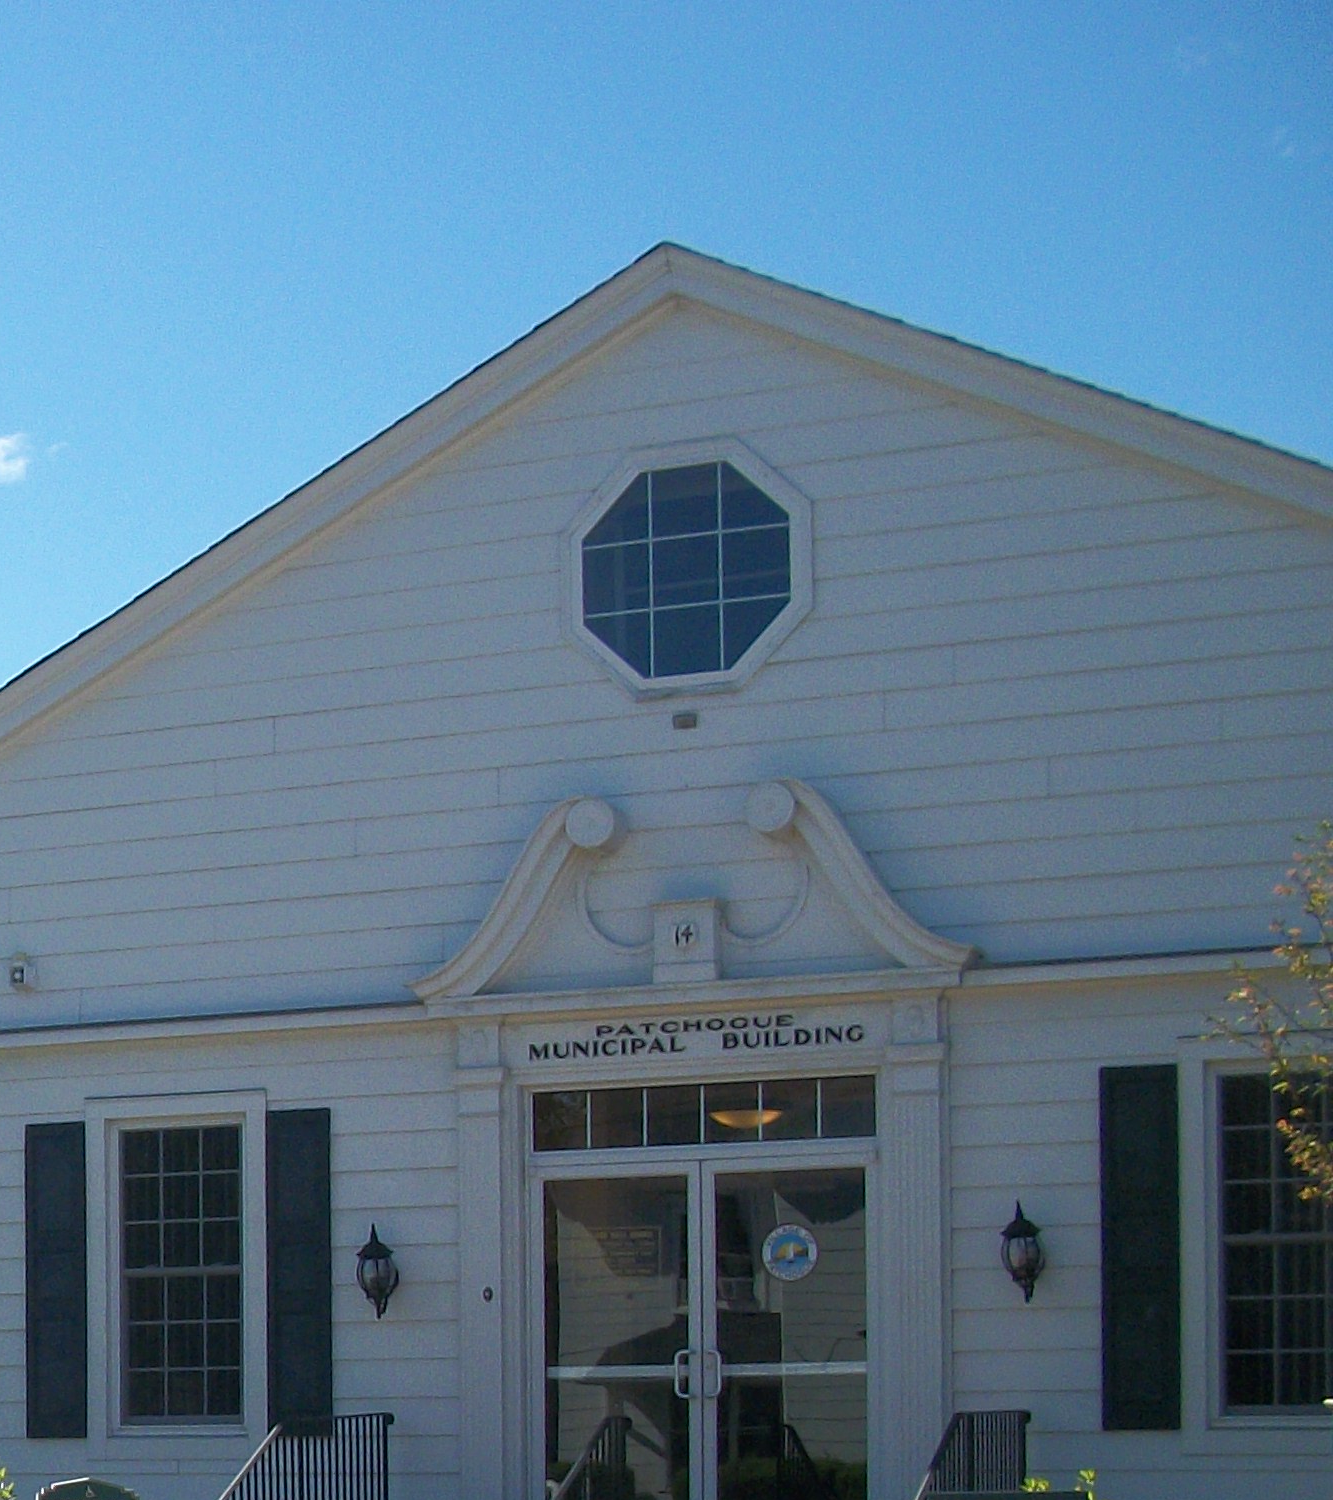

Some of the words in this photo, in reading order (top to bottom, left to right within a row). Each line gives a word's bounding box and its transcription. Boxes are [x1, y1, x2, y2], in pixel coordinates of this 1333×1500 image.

[675, 924, 693, 947] 14
[529, 1036, 687, 1061] MUNICIPAL
[722, 1024, 865, 1050] BUILDING
